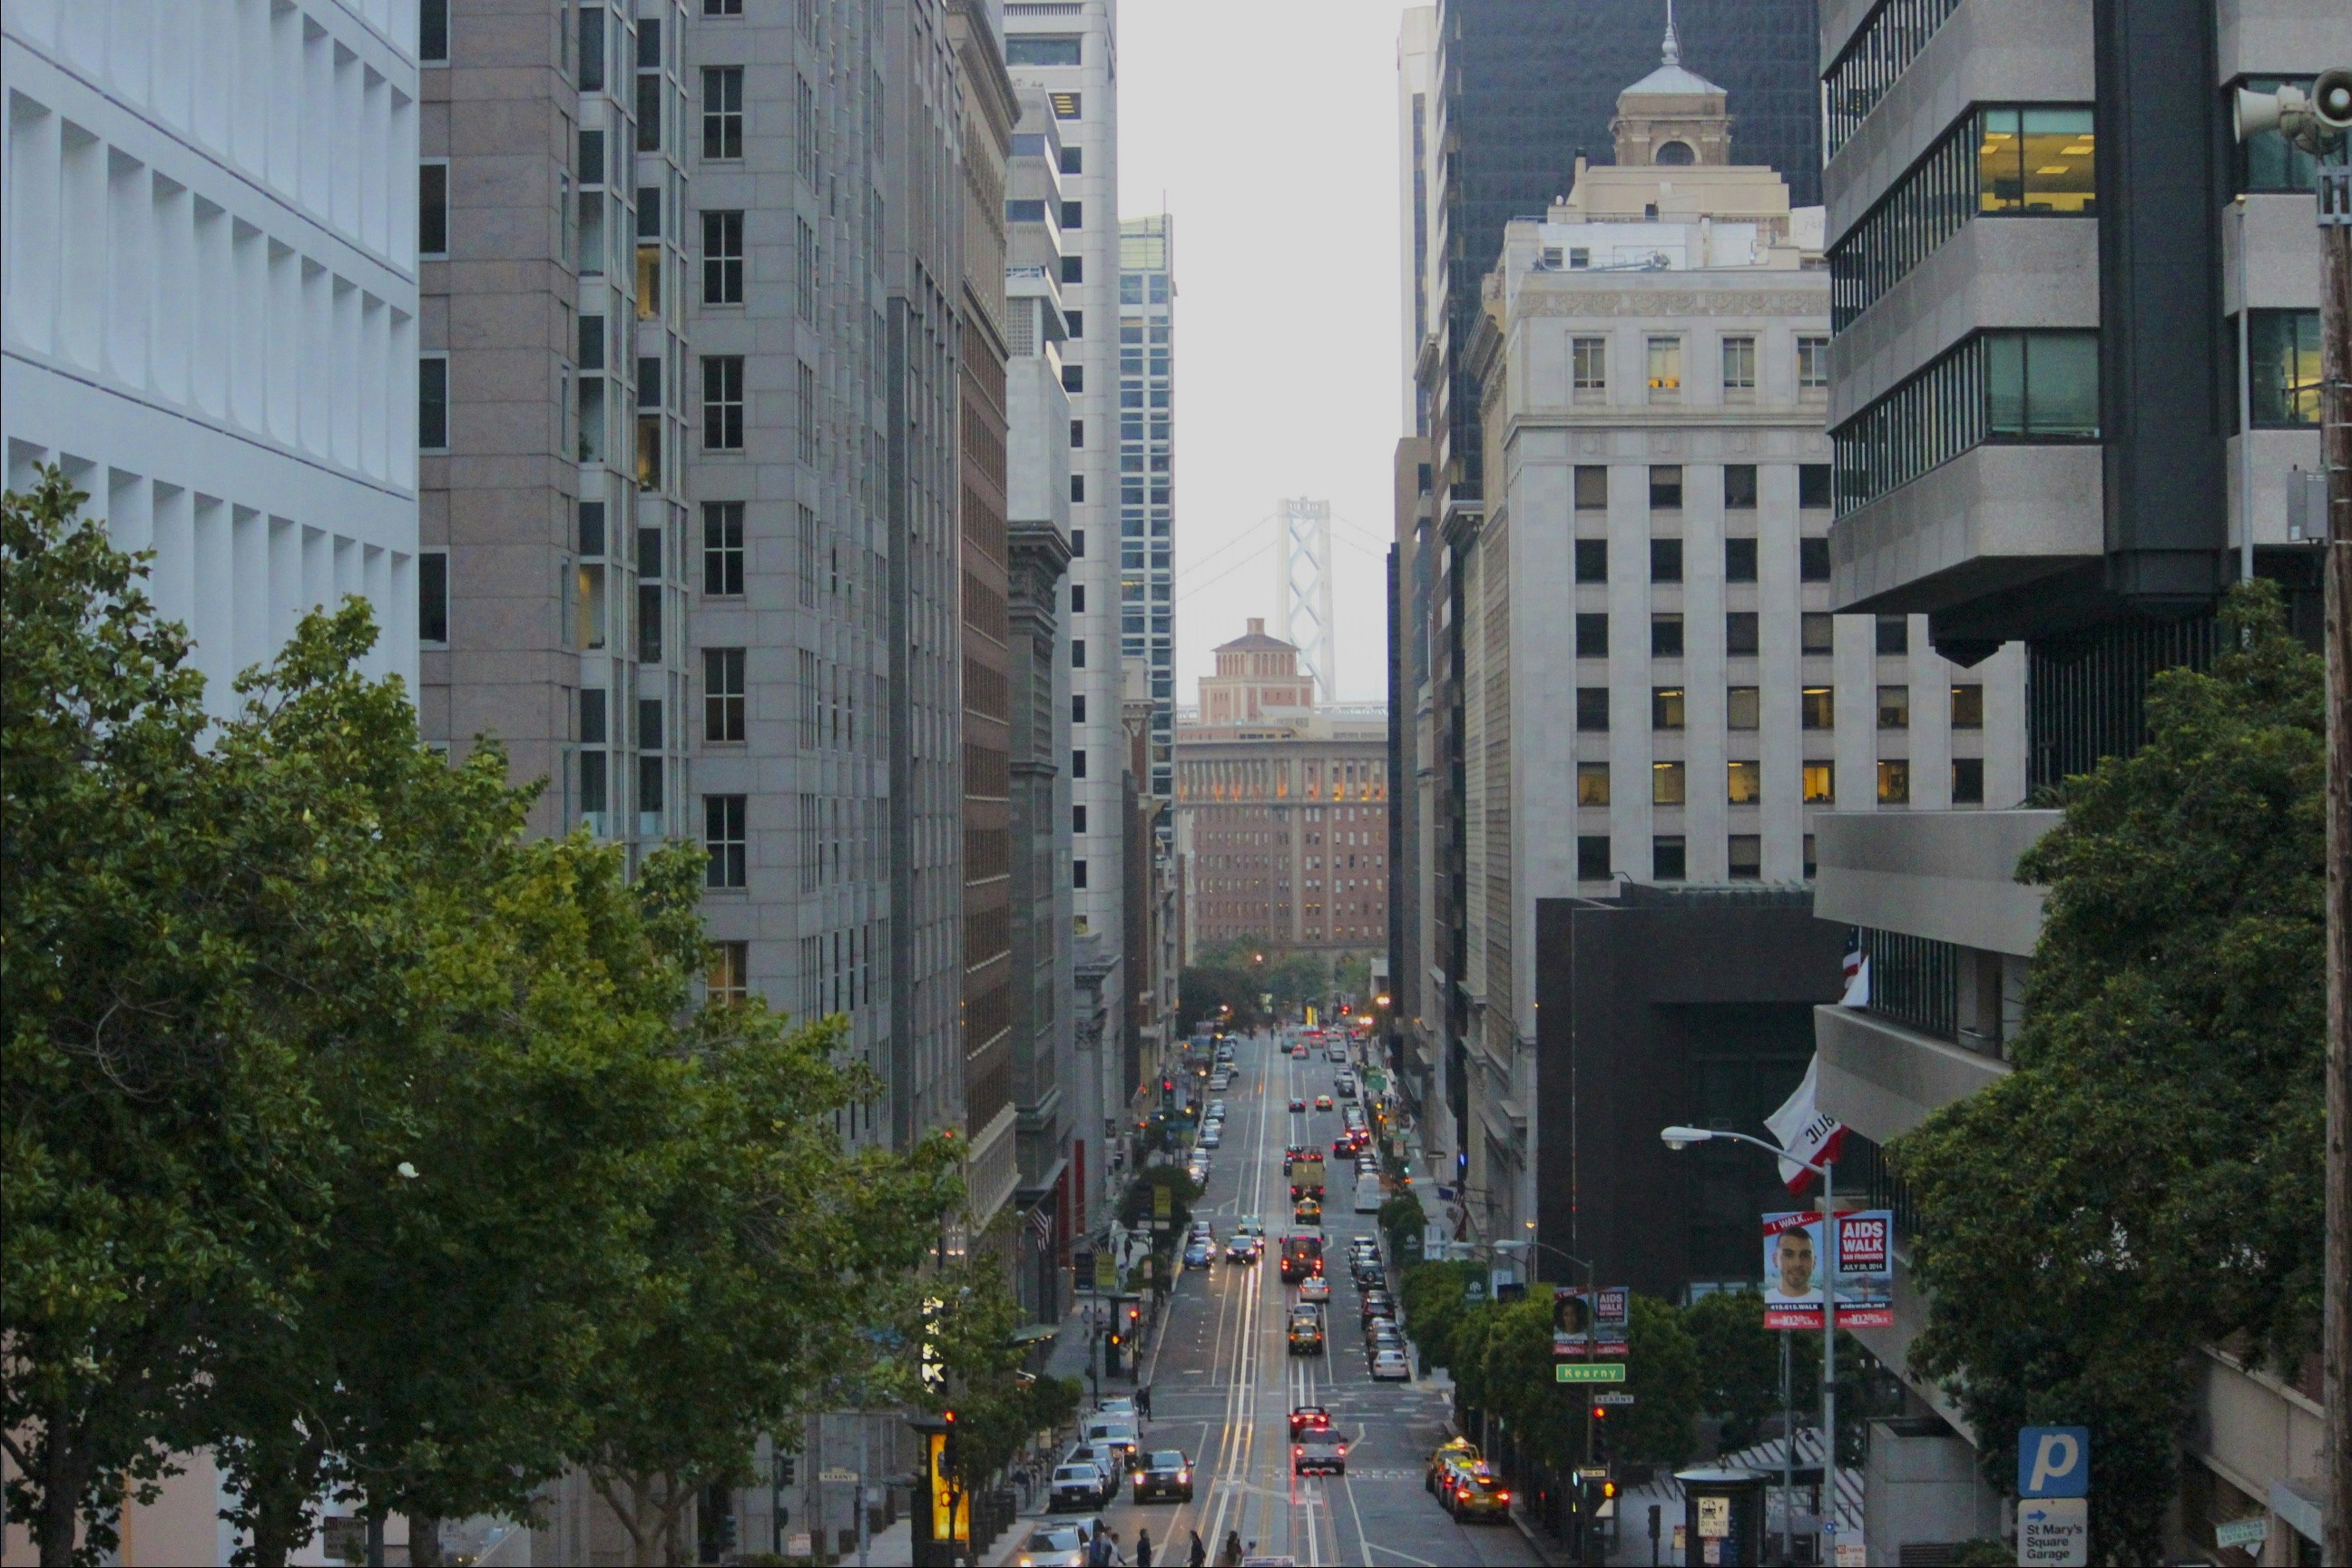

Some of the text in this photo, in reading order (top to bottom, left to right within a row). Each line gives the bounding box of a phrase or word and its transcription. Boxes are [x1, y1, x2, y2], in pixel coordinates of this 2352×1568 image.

[1843, 1221, 1884, 1239] AIDS
[1843, 1239, 1884, 1252] WALK
[1600, 1293, 1623, 1303] AIDS
[1599, 1303, 1623, 1311] WALK
[1564, 1367, 1617, 1379] Kearny
[2027, 1524, 2082, 1536] St Mary's
[2027, 1536, 2069, 1549] Square
[2027, 1549, 2070, 1560] Garage
